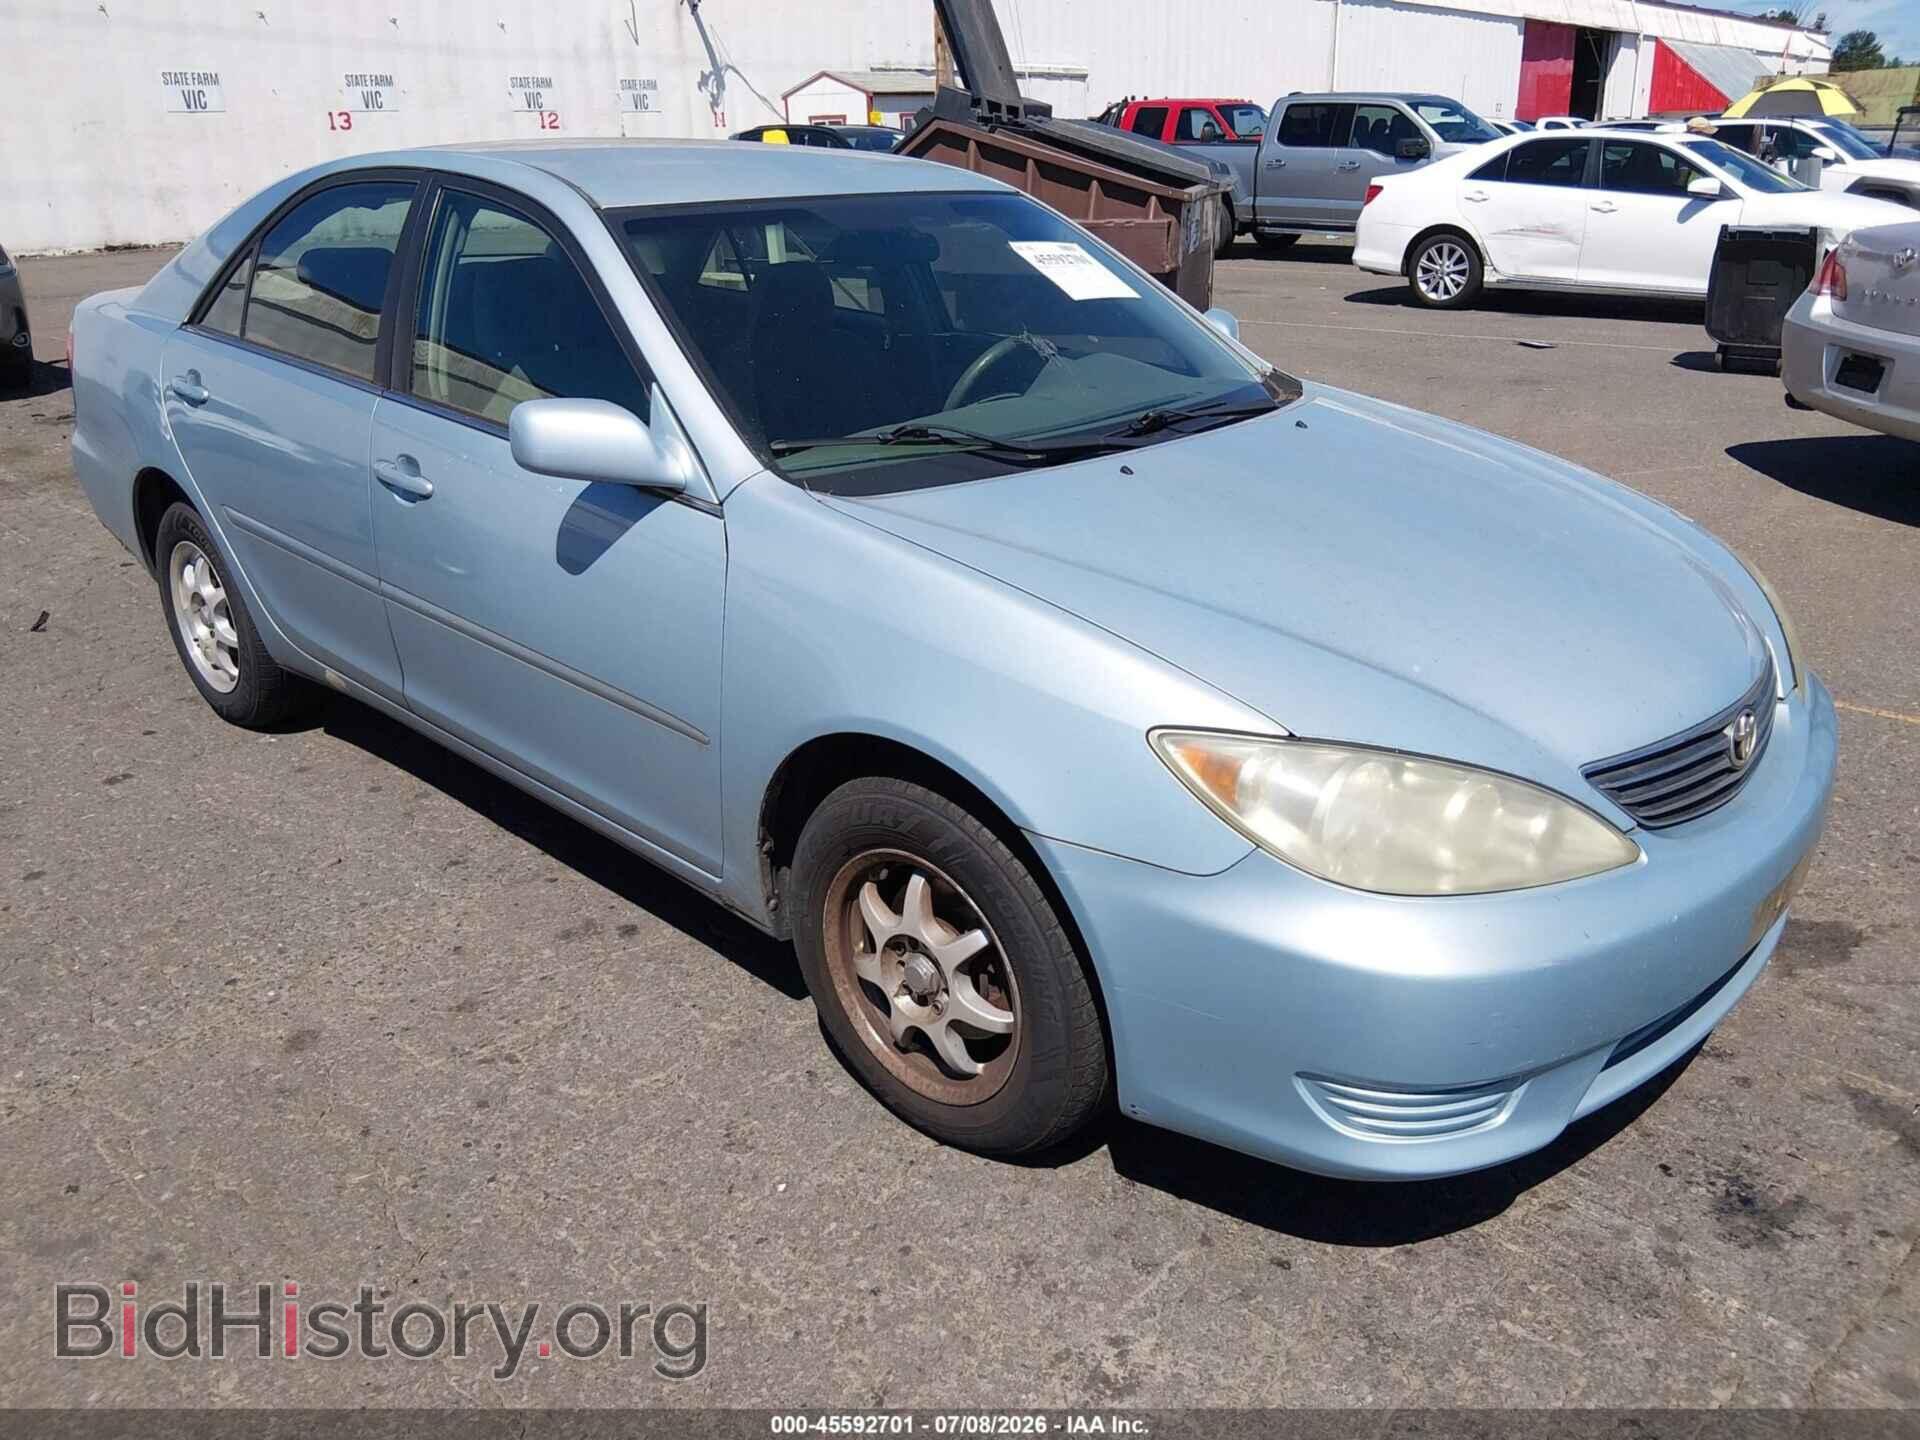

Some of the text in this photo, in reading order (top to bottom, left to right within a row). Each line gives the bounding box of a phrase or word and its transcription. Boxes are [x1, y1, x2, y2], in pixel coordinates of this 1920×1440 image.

[161, 71, 220, 87] STATE FARM
[344, 74, 394, 88] STATE FARM
[510, 76, 553, 89] STATE FARM
[620, 79, 658, 90] STATE FARM
[182, 89, 208, 110] VIC
[361, 90, 383, 109] VIC
[524, 91, 544, 109] VIC
[632, 93, 649, 110] VIC
[327, 111, 353, 131] 13
[539, 111, 560, 130] 12
